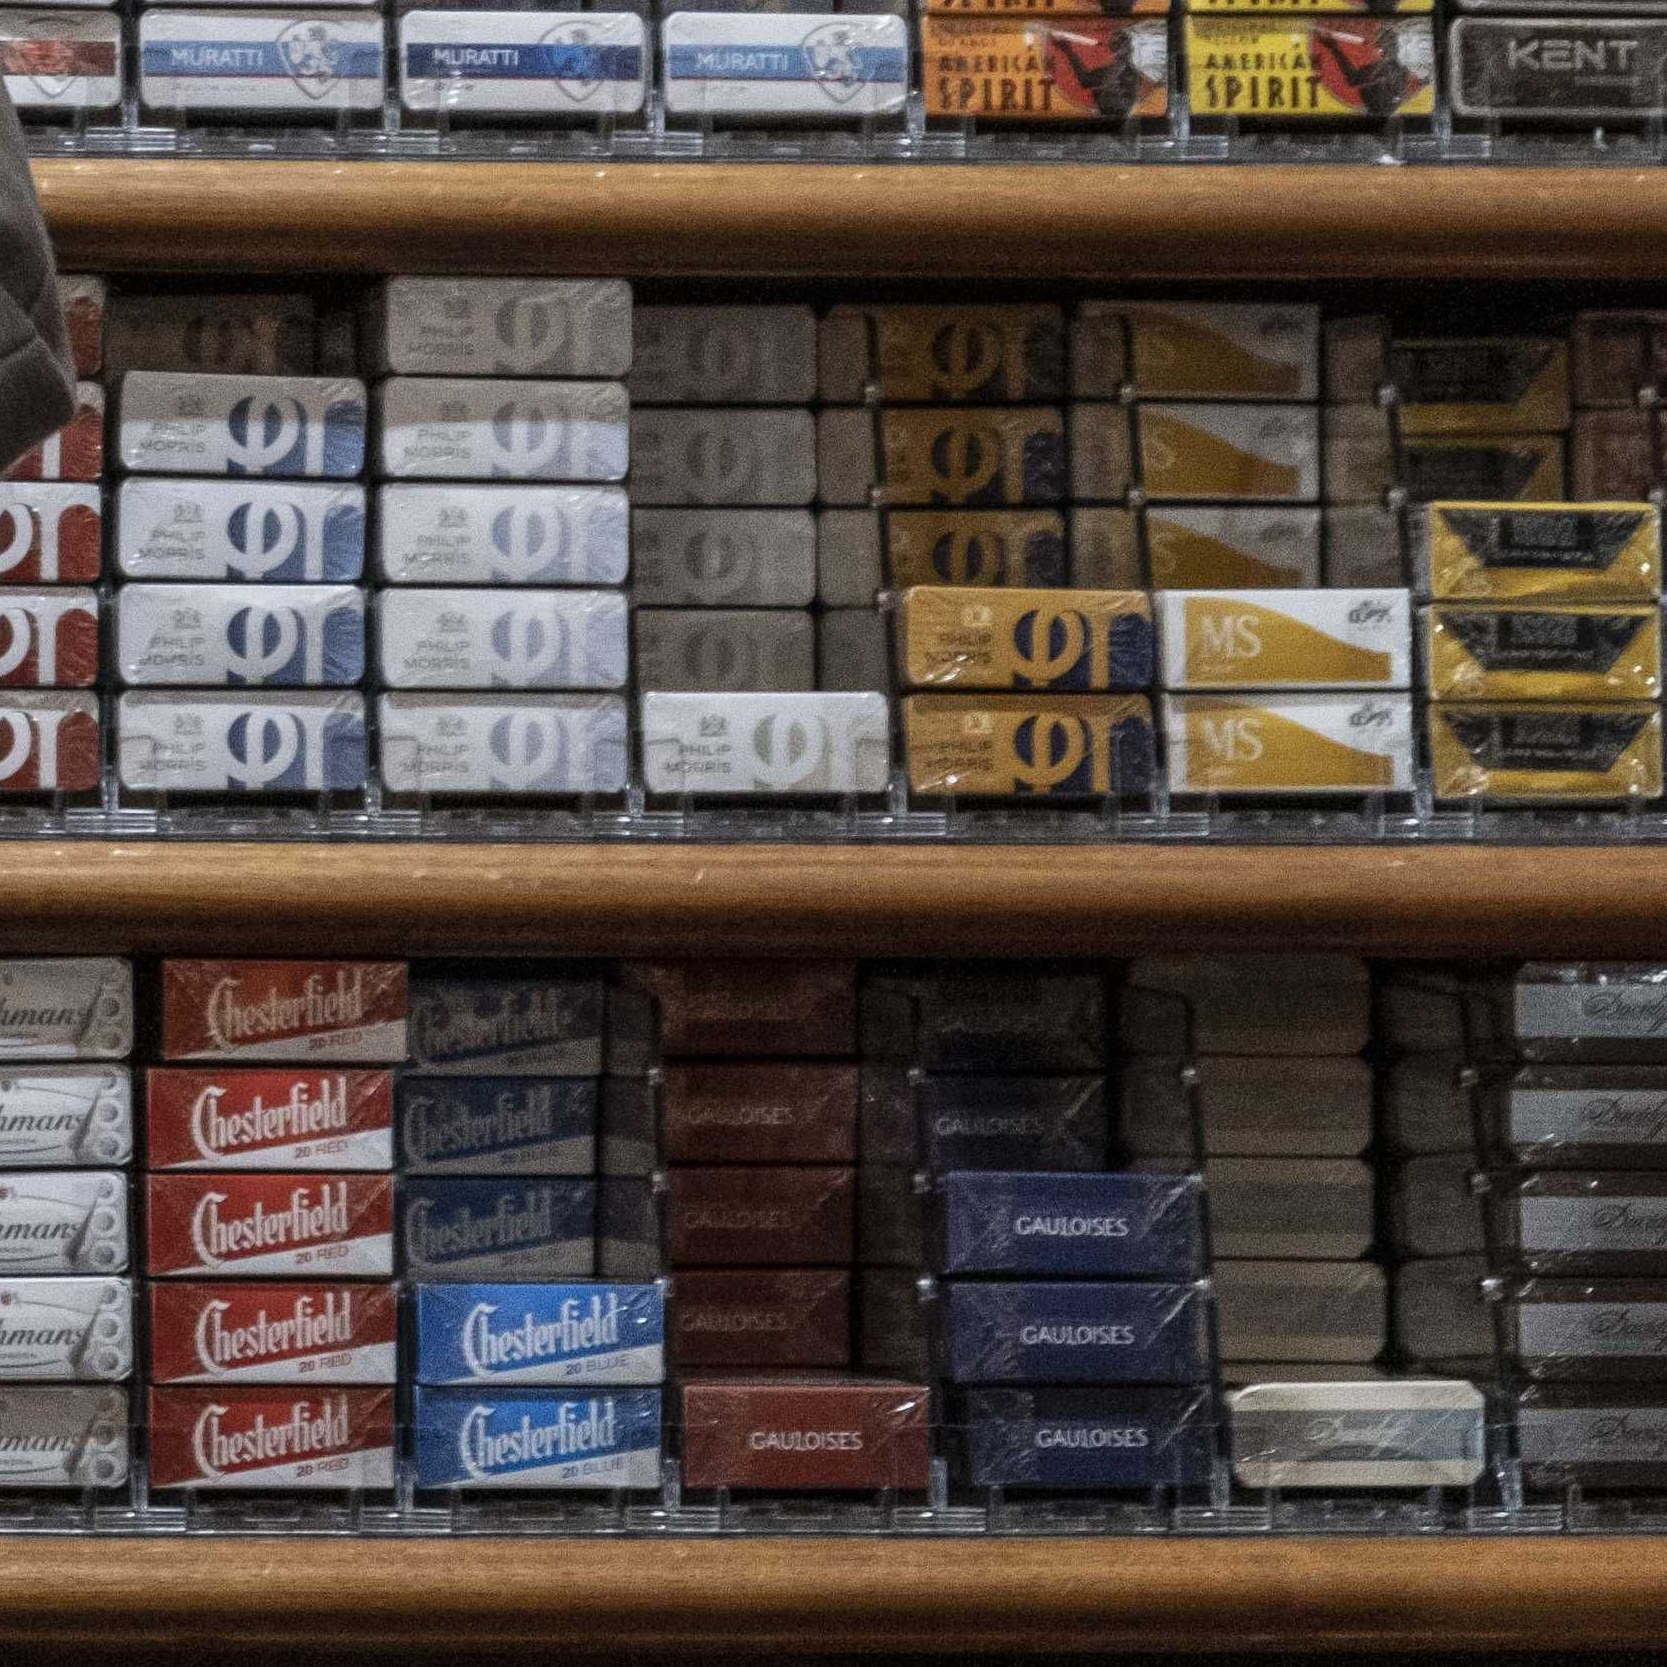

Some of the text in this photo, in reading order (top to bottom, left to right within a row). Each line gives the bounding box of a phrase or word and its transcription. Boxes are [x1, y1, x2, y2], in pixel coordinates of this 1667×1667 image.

[431, 47, 520, 68] MURATTI
[1507, 39, 1639, 71] KENT
[1201, 613, 1263, 659] MS
[189, 1077, 350, 1162] Chesterfield
[294, 1139, 349, 1160] 20 RED
[191, 1183, 351, 1267] Chesterfield
[1014, 1216, 1129, 1238] GAULOISES
[463, 1293, 624, 1378] Chesterfield
[748, 1430, 864, 1452] GAULOISES
